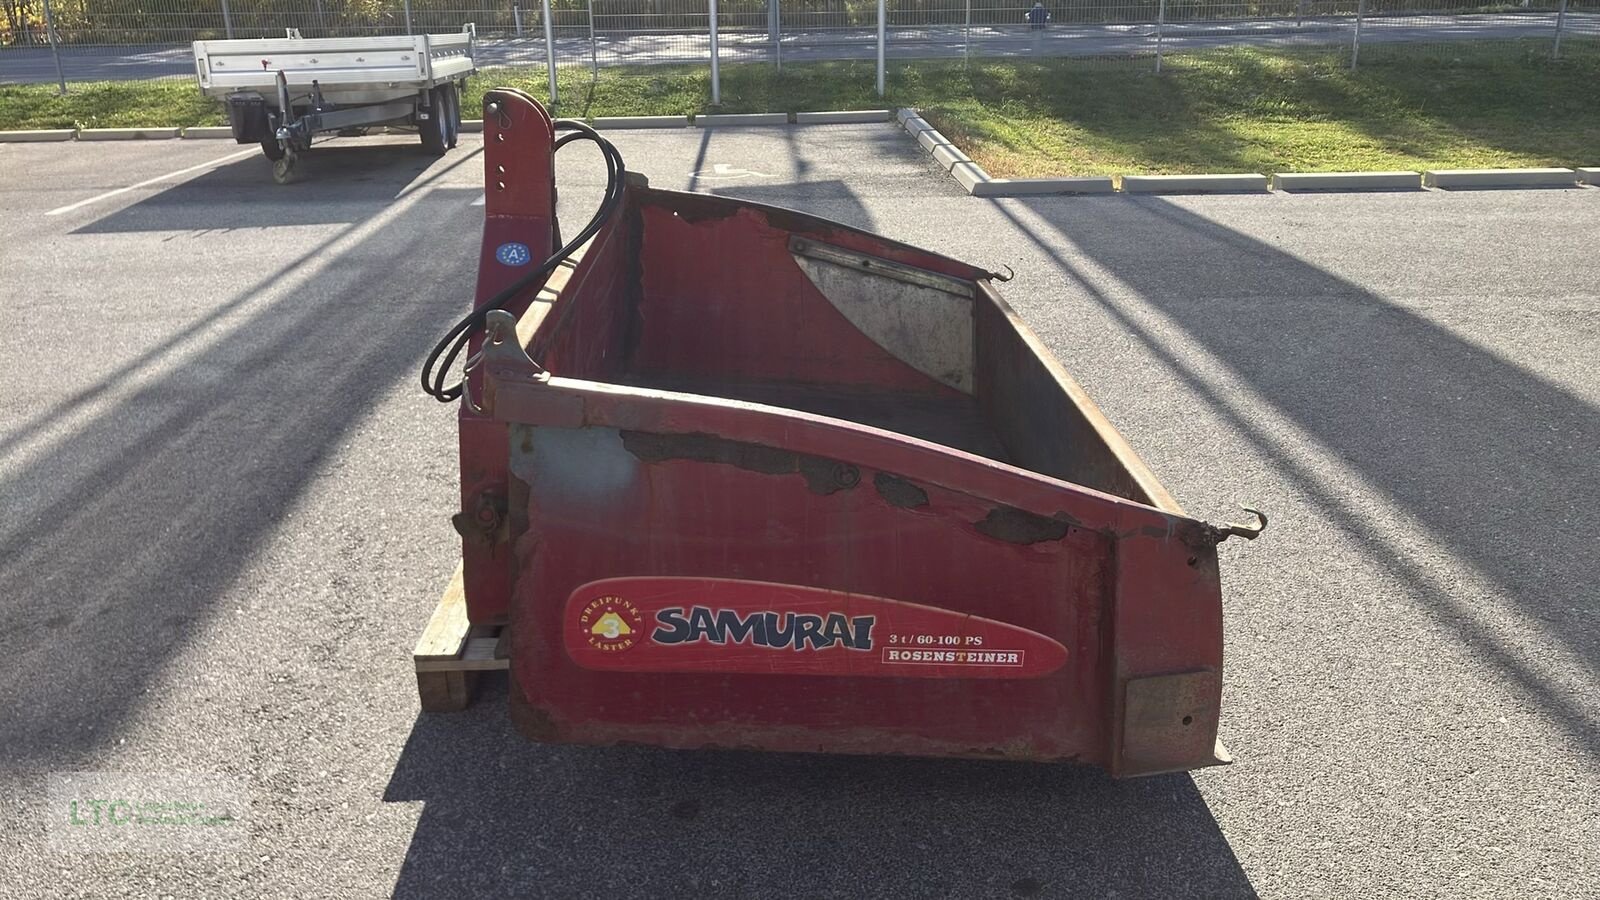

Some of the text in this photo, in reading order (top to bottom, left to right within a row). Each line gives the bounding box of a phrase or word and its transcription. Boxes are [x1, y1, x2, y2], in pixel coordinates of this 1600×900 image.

[508, 248, 519, 259] A
[581, 596, 642, 623] DREIPUNKT
[602, 617, 620, 639] 3
[651, 605, 876, 651] SAMURAI
[588, 636, 632, 651] LASTER
[889, 634, 898, 644] 3
[917, 635, 961, 646] 60-100
[965, 636, 983, 646] PS
[888, 650, 1018, 663] ROSENSTEINER
